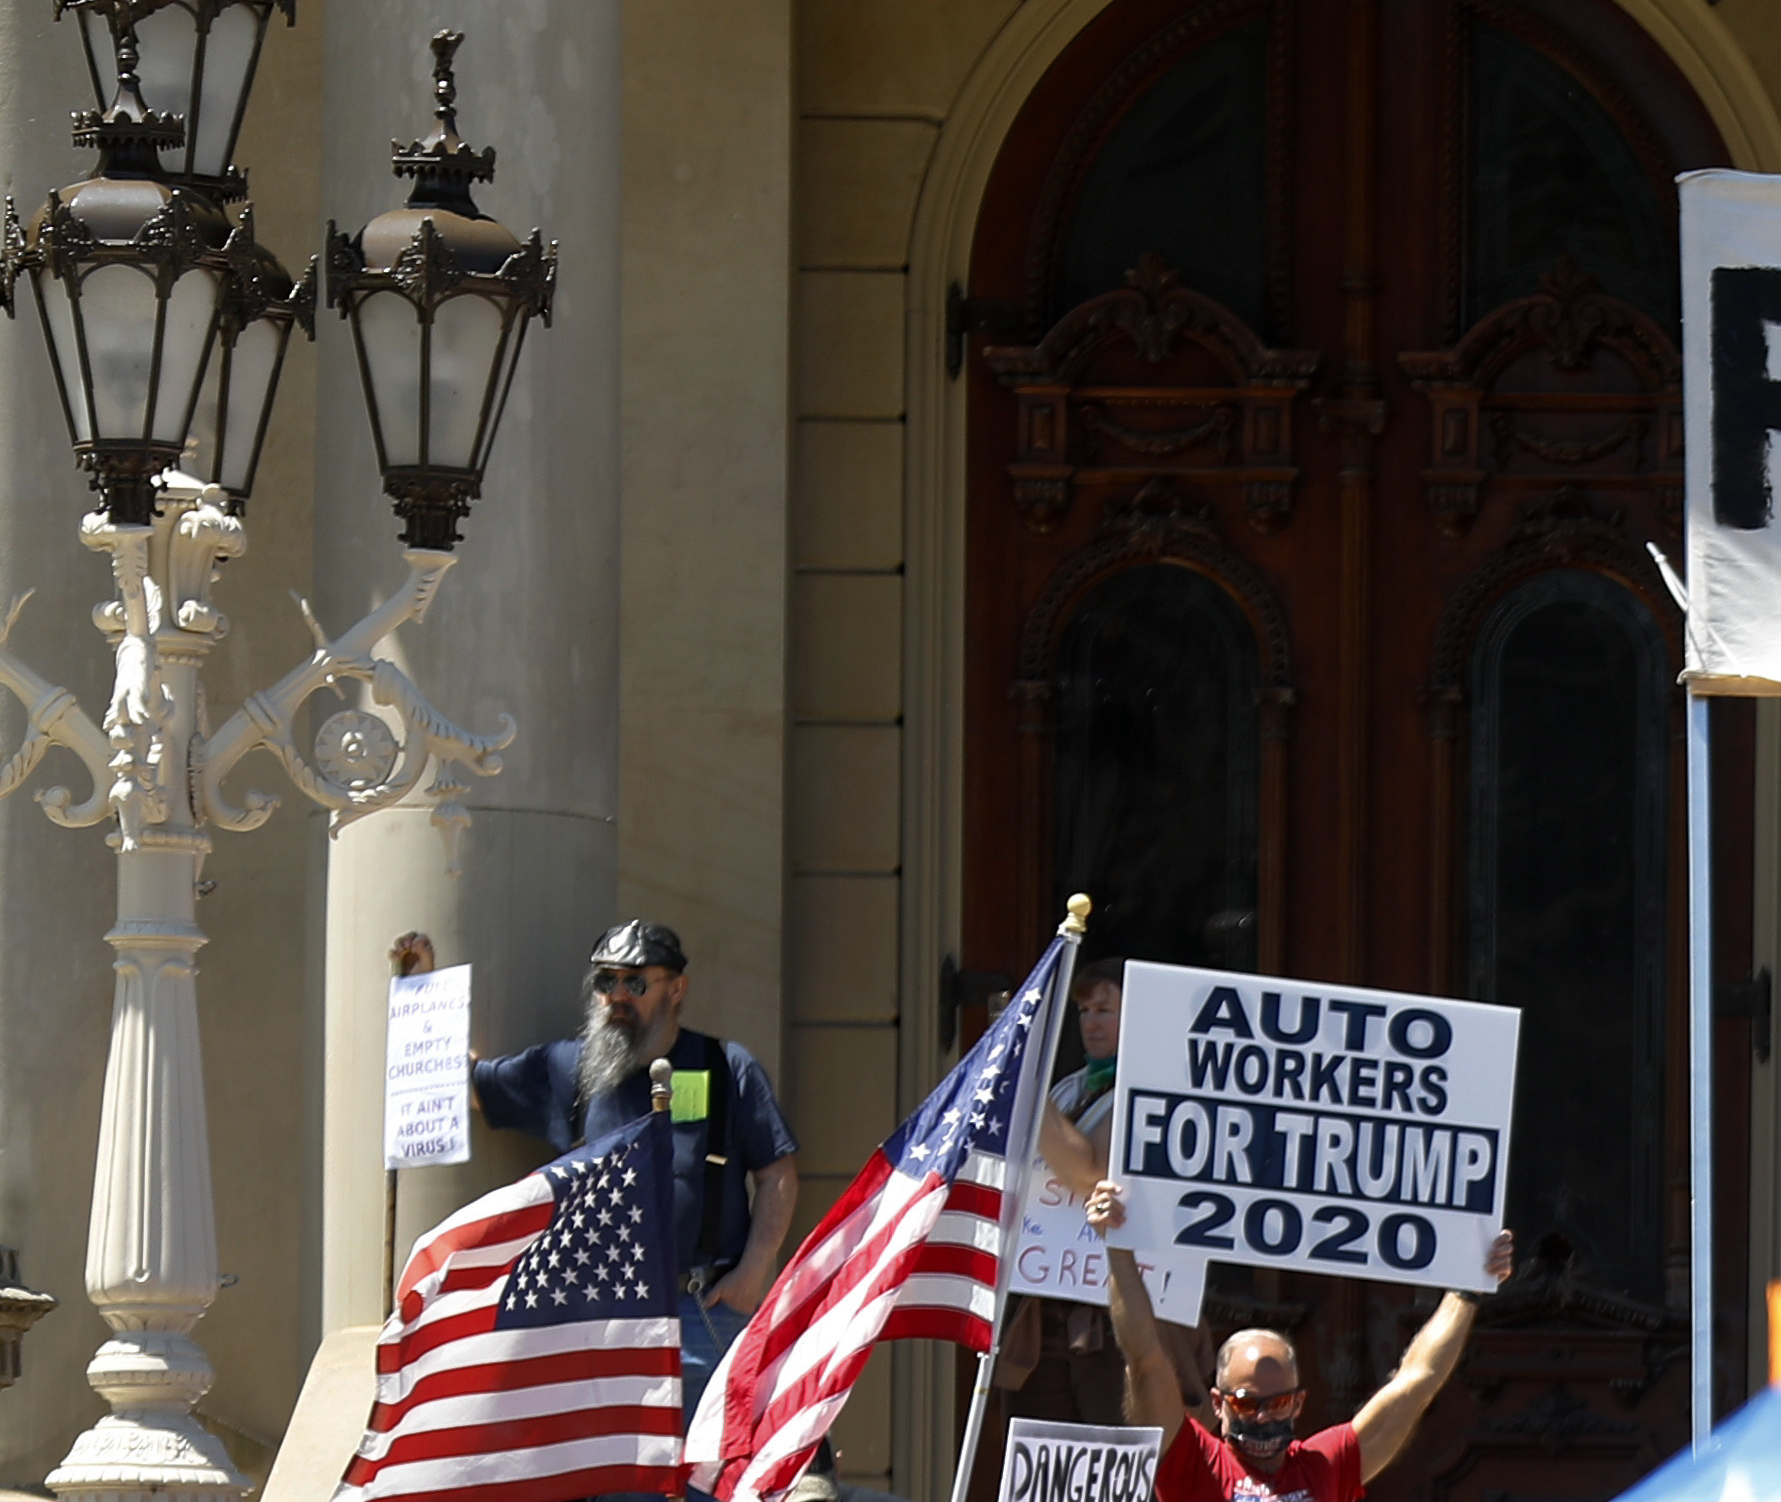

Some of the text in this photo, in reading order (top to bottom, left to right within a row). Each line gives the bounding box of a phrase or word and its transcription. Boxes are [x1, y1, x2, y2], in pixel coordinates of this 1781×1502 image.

[403, 1035, 453, 1058] EMPTY
[1187, 984, 1455, 1060] AUTO
[1186, 1037, 1450, 1117] WORKERS
[396, 1114, 461, 1141] ABOUT A
[1128, 1094, 1493, 1208] FOR TRUMP
[1173, 1191, 1438, 1271] 2020
